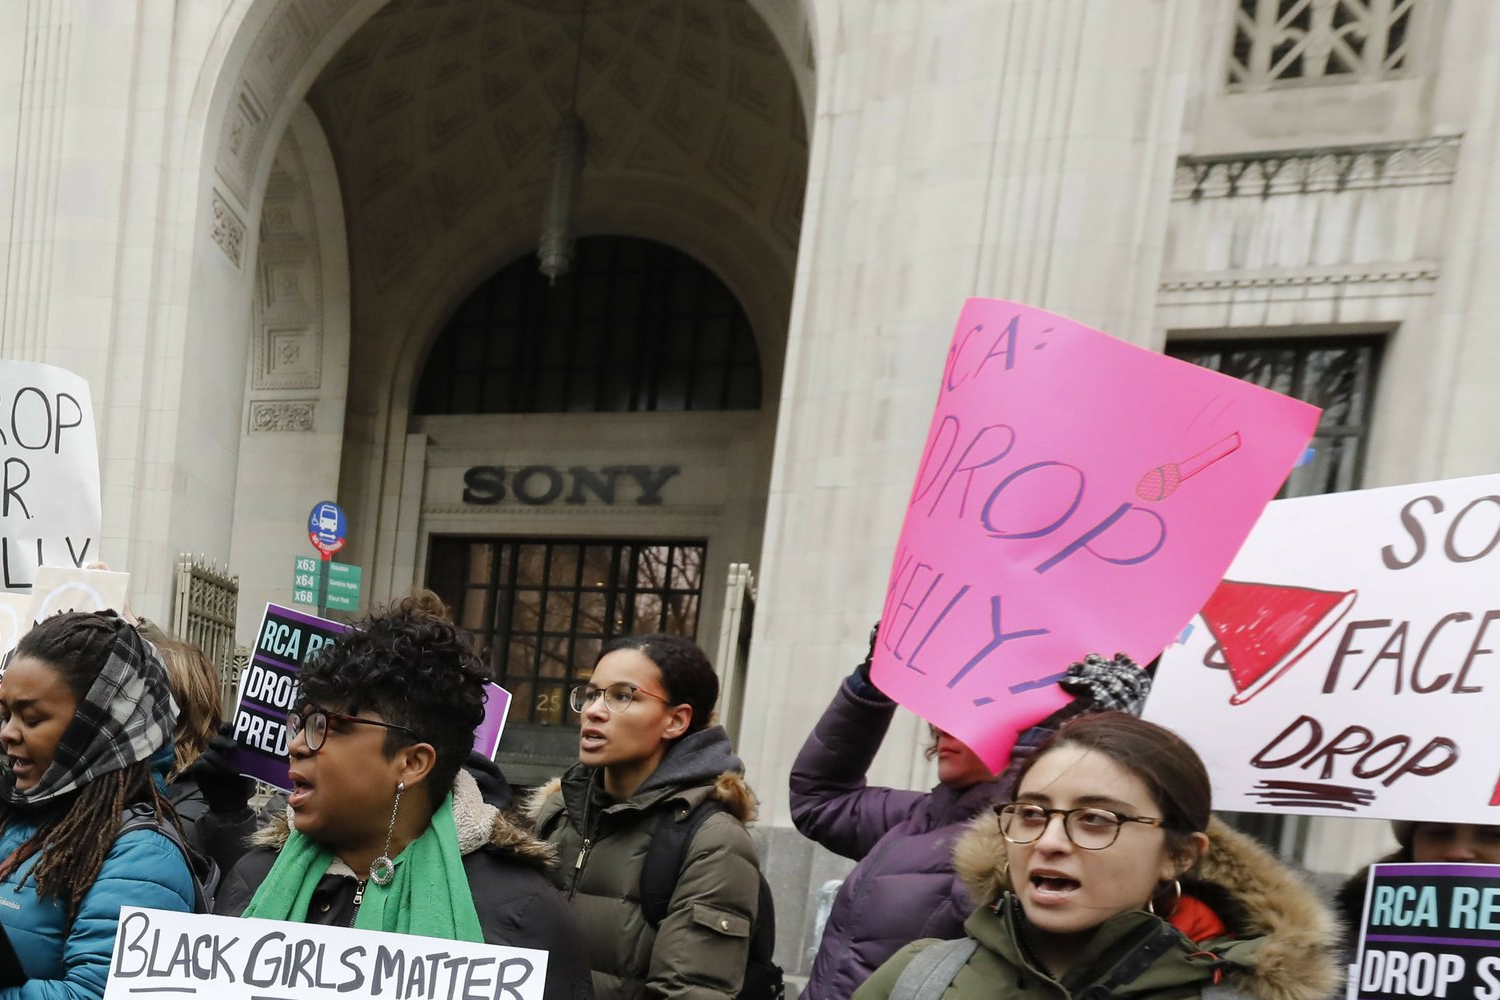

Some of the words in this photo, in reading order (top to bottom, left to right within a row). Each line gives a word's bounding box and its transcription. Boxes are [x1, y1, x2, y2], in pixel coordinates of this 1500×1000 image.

[2, 457, 34, 520] R.
[462, 465, 681, 506] SONY
[911, 415, 1167, 575] DROP
[295, 575, 314, 588] X64
[296, 559, 316, 572] X63
[294, 590, 313, 603] X68
[260, 620, 301, 660] RCA
[536, 694, 563, 713] 25
[1250, 715, 1460, 788] DROP
[1372, 885, 1439, 928] RCA
[113, 911, 241, 983] BLACK
[243, 931, 365, 993] GIRLS
[1361, 950, 1466, 998] DROP
